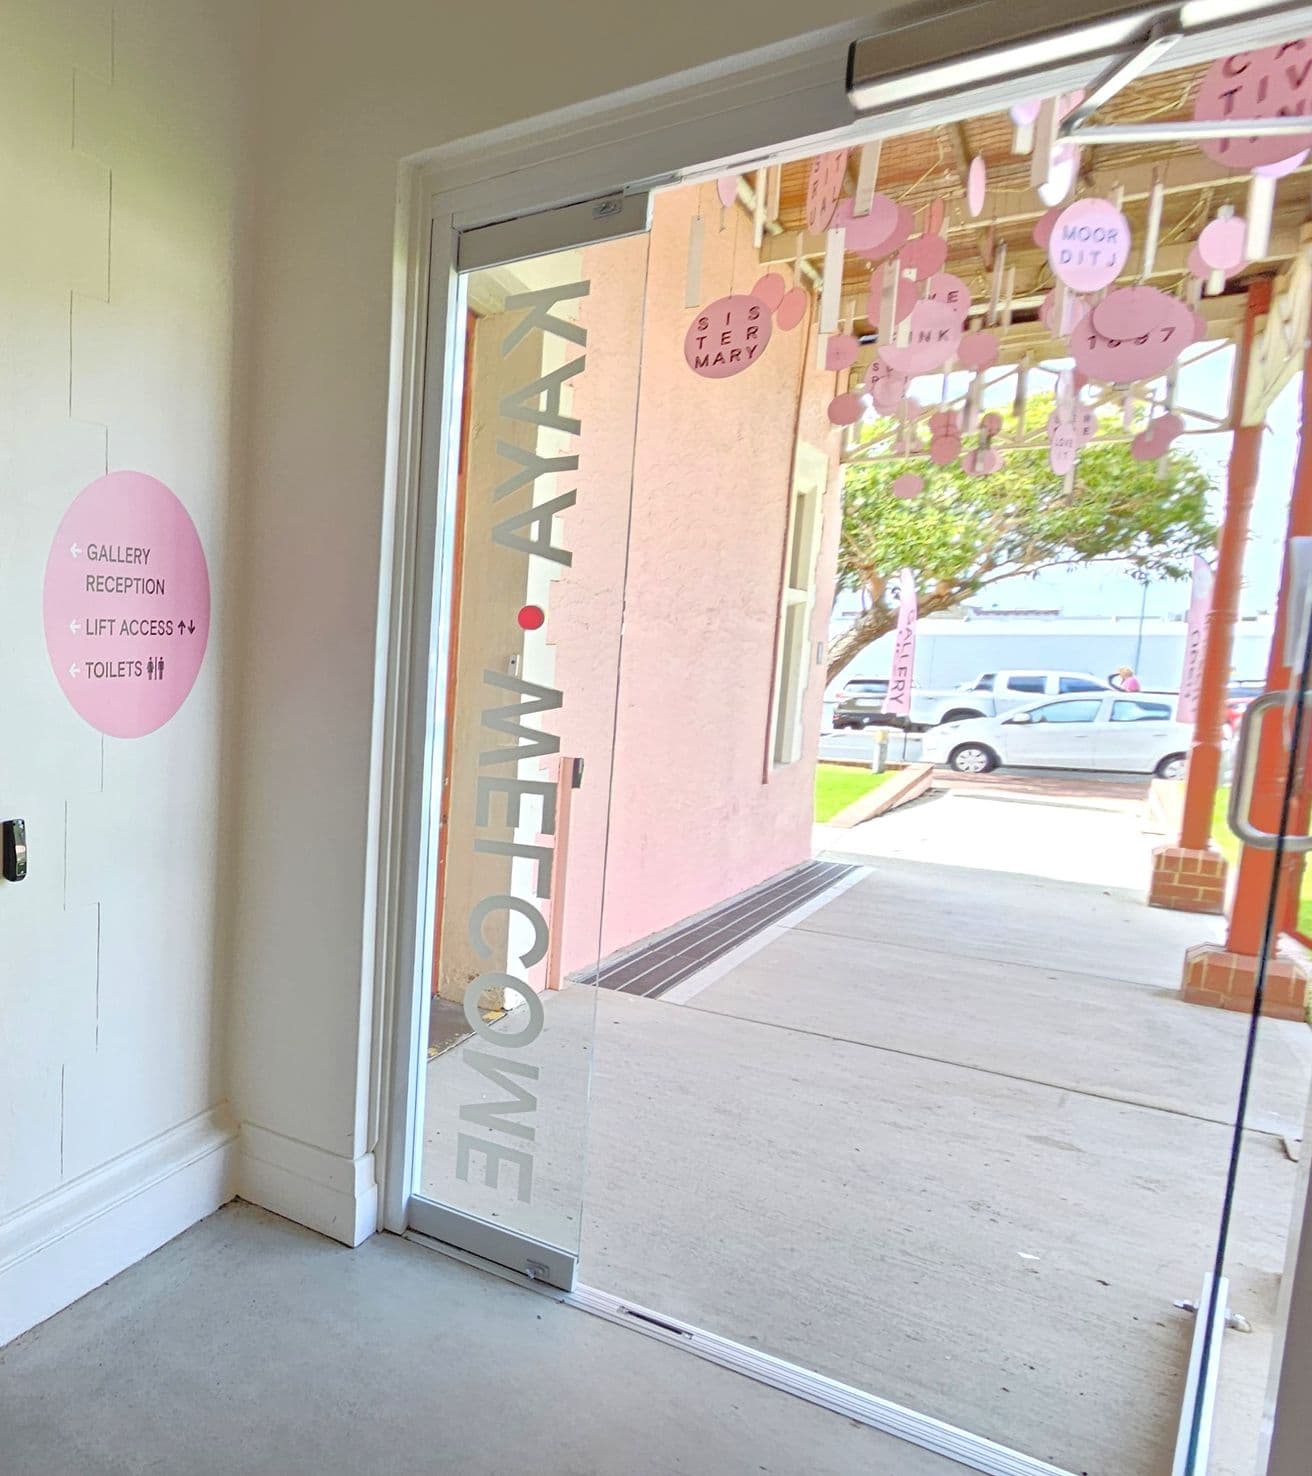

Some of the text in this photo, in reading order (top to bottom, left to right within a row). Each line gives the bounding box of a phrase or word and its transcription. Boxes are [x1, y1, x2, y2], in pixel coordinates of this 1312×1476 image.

[1062, 226, 1118, 243] MOOR
[1059, 249, 1116, 267] DITJ
[697, 305, 760, 331] SIS
[696, 325, 759, 350] TER
[695, 344, 758, 368] MARY
[87, 544, 150, 565] GALLERY
[86, 574, 165, 595] RECEPTION
[86, 619, 174, 636] LIFT ACCESS
[85, 660, 143, 679] TOILETS
